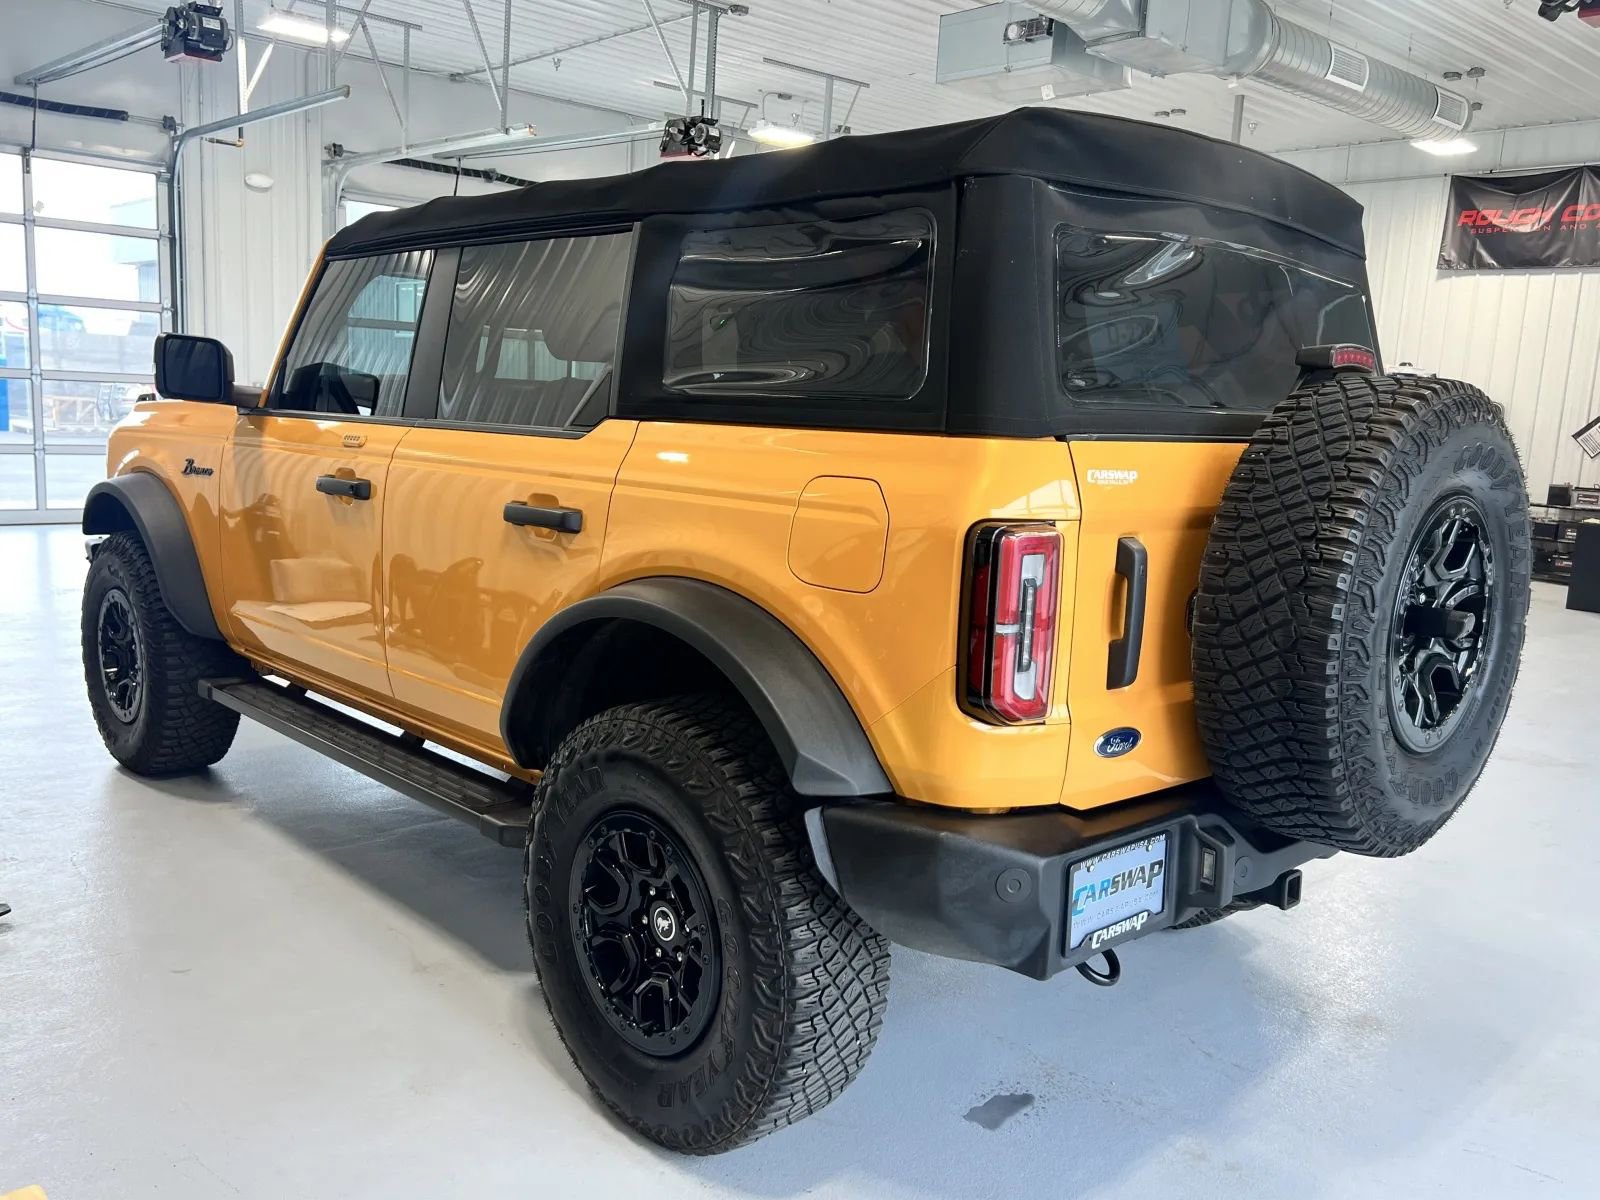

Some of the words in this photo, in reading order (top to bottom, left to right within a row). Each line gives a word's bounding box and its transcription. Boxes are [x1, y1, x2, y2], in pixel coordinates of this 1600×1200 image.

[1106, 736, 1133, 753] Ford
[1071, 859, 1164, 917] CARSWAP
[1091, 911, 1149, 950] CARSWAP
